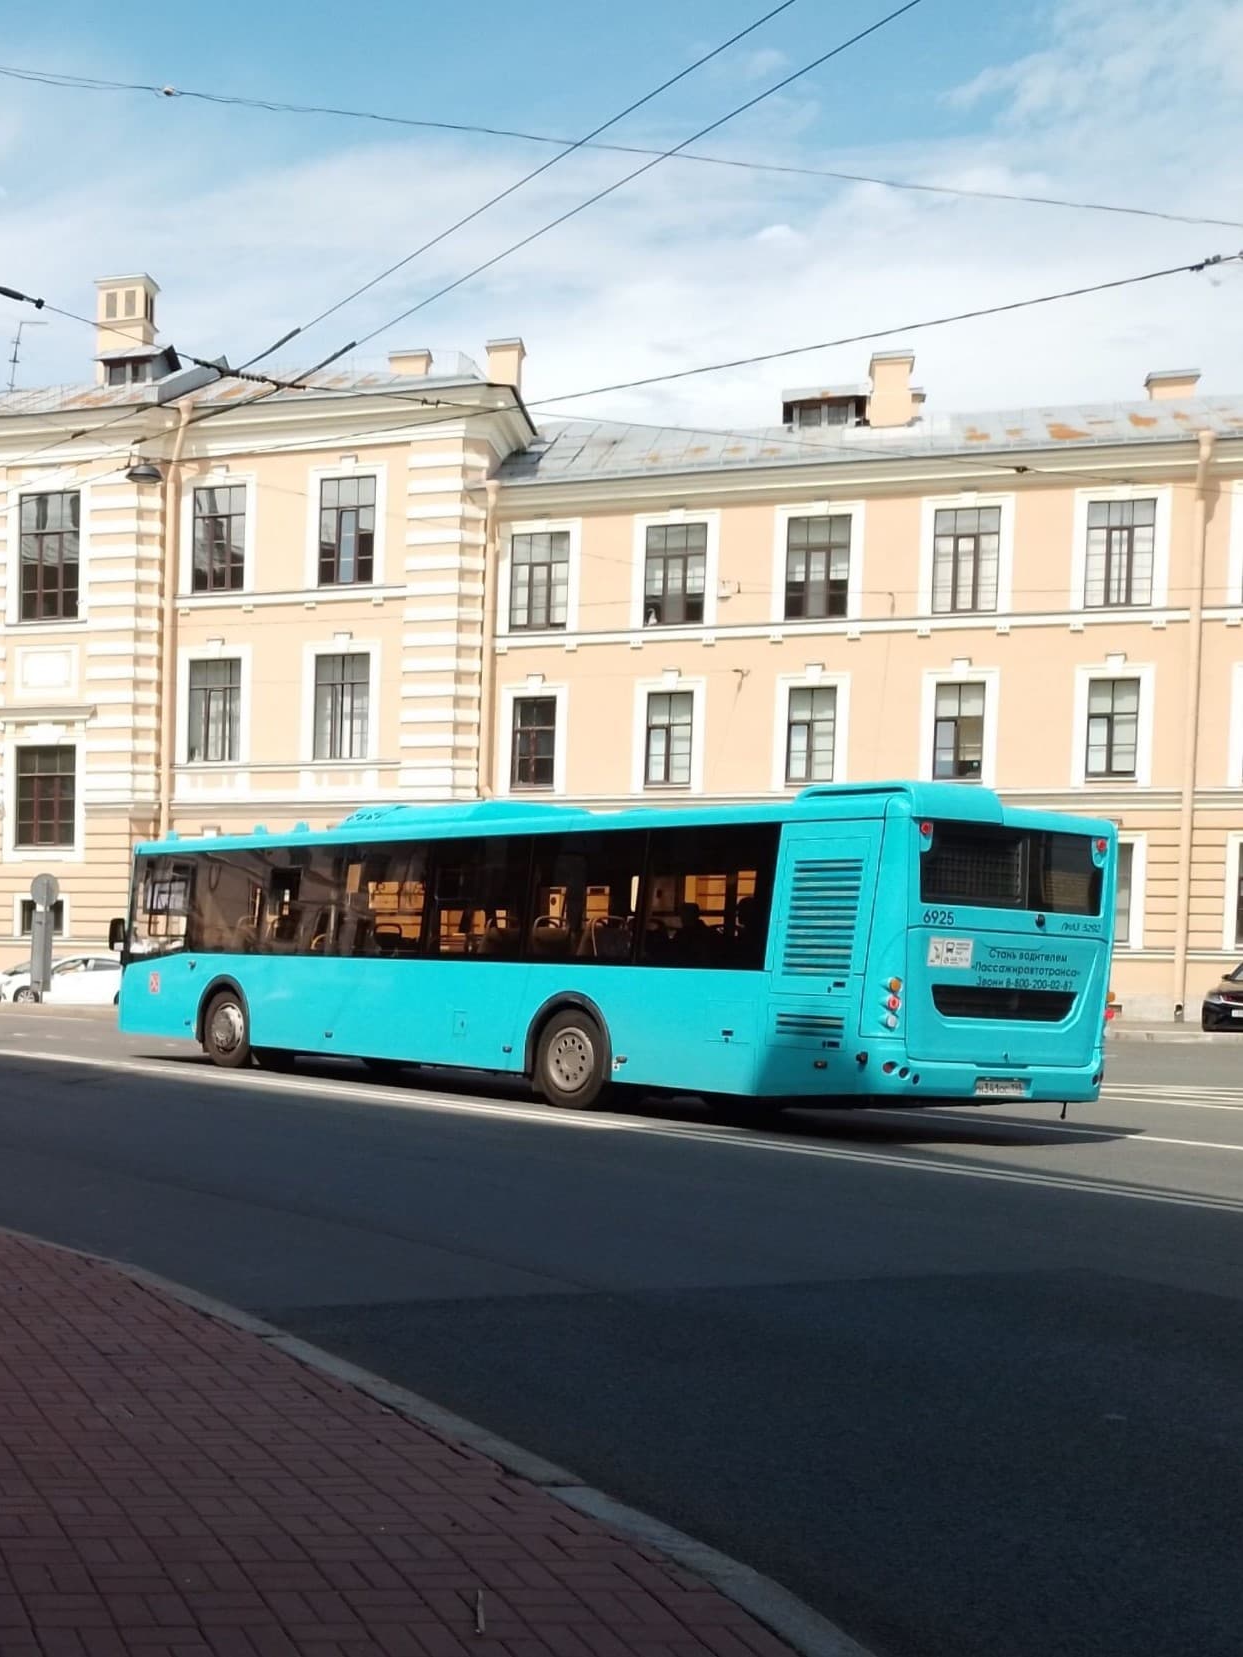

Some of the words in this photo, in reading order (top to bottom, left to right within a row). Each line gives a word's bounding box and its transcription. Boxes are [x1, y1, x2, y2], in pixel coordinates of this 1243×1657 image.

[923, 909, 955, 925] 6925
[1019, 951, 1067, 963] водителем
[976, 976, 1004, 987] Звони
